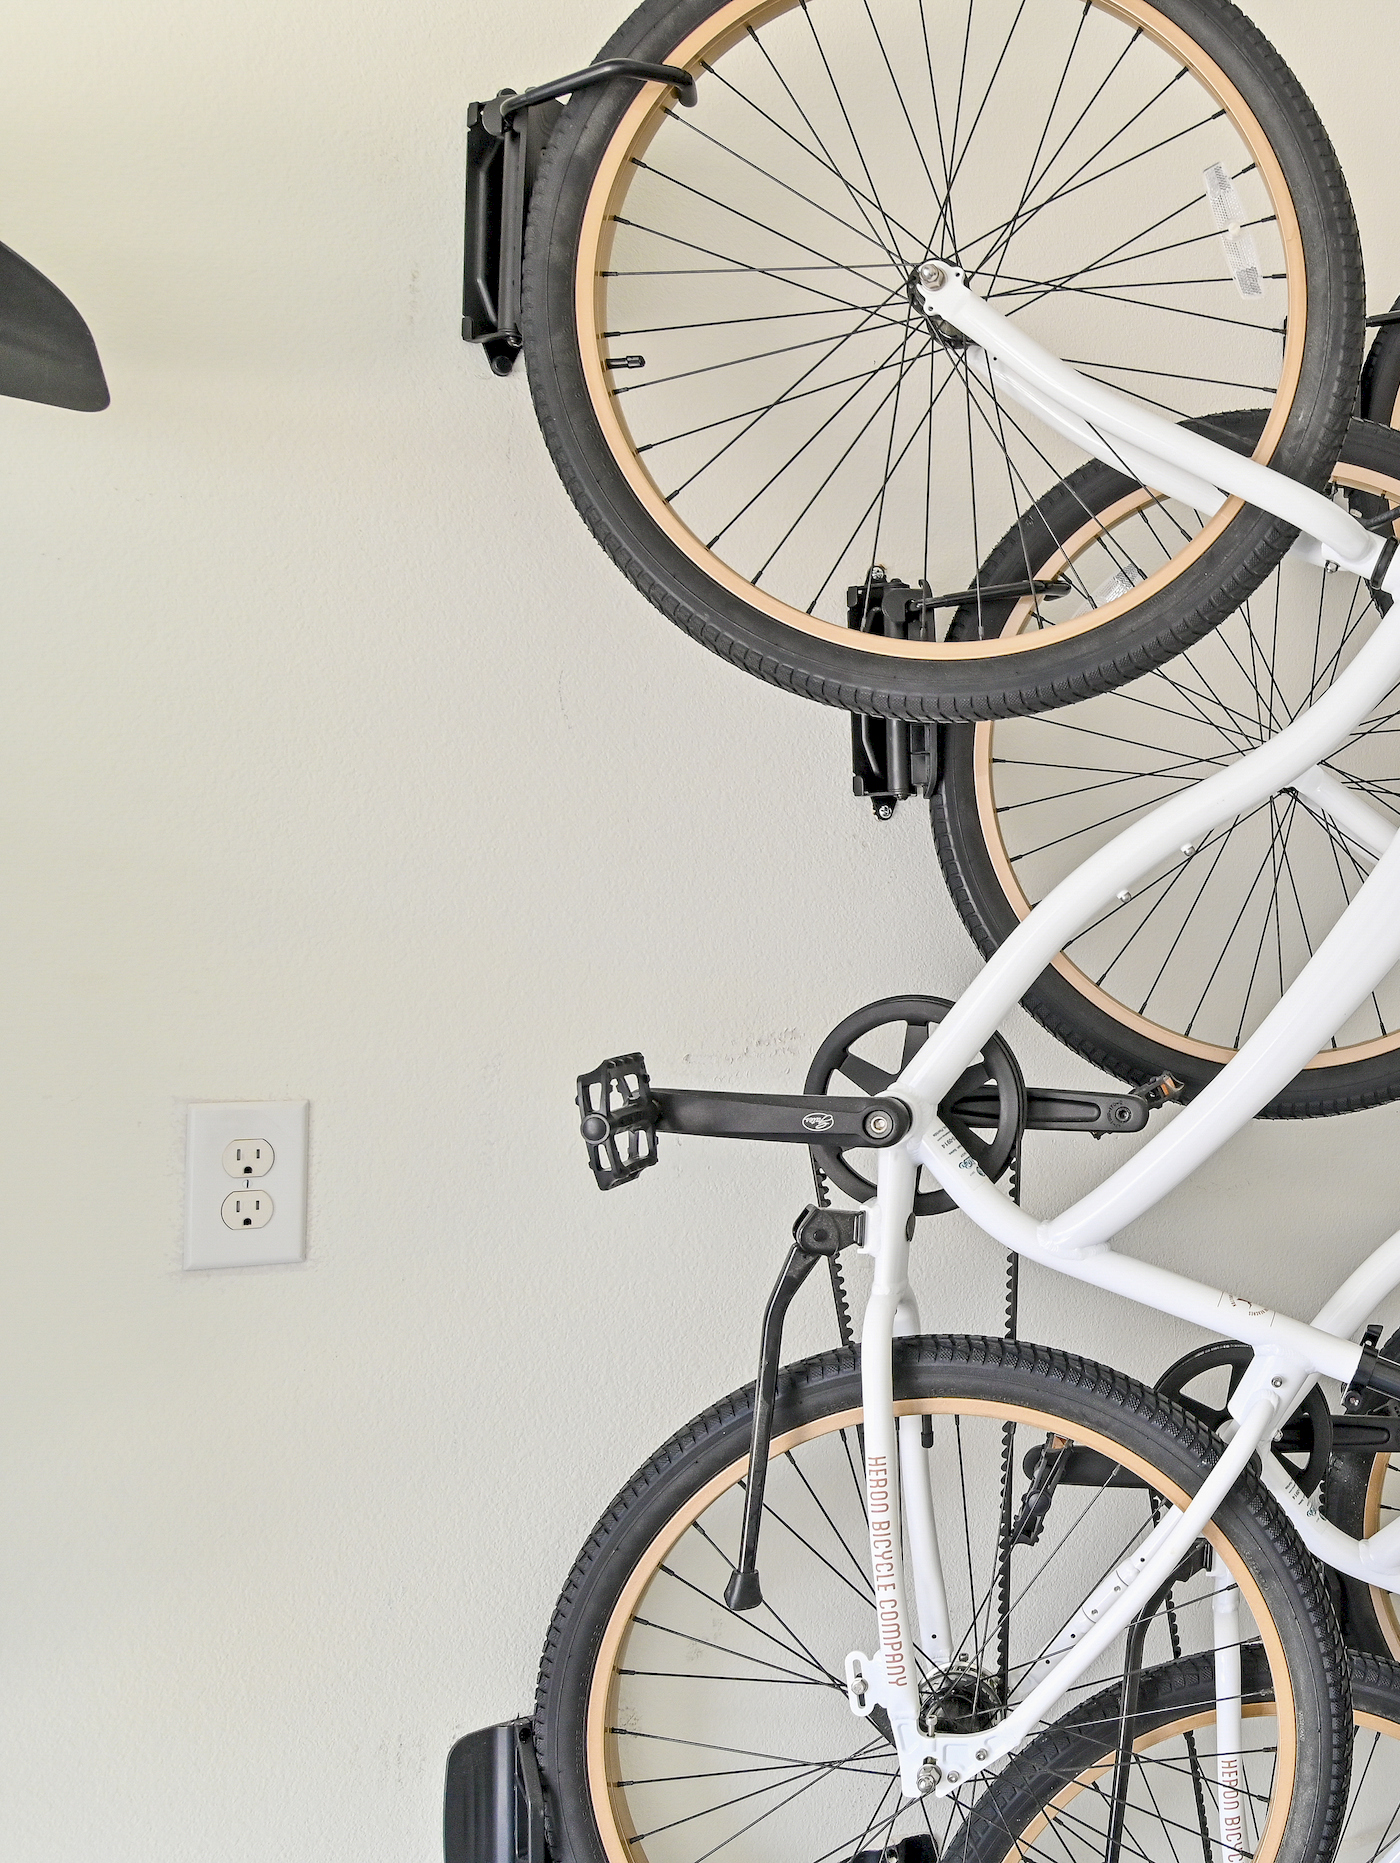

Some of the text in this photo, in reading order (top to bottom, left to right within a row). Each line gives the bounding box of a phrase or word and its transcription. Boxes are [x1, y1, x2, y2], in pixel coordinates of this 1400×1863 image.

[868, 1456, 908, 1687] HERON BICYCLE COMPANY
[1224, 1815, 1245, 1863] BICYC
